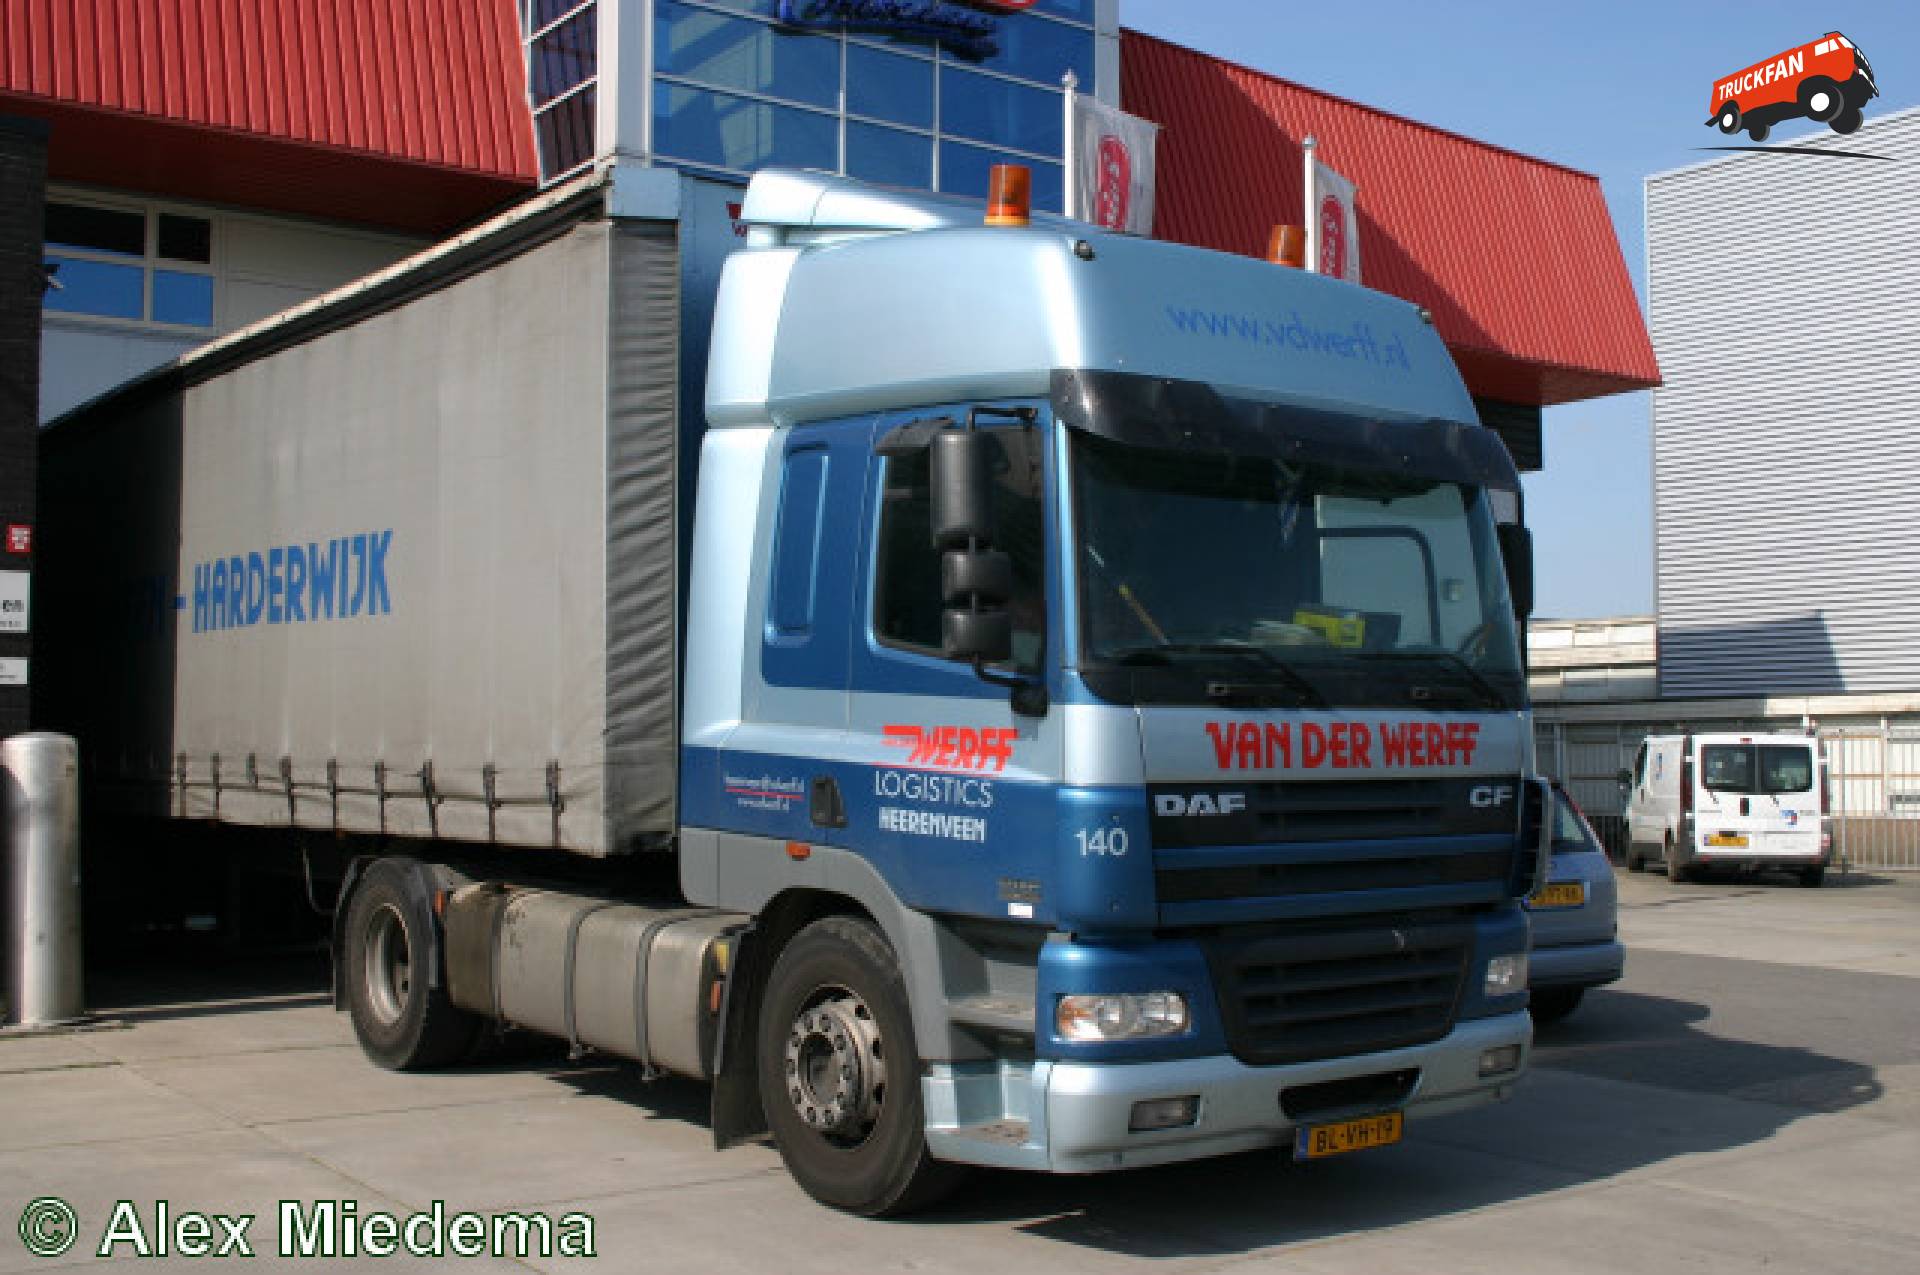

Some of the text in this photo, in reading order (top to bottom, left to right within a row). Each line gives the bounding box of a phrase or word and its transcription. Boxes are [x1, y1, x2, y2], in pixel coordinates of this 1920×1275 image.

[1166, 304, 1412, 369] www.vdwerff.nl
[192, 528, 394, 634] HARDERWIJK
[882, 725, 1019, 771] WERFF
[1205, 722, 1480, 769] VAN DER WERFF
[874, 770, 994, 808] LOGISTICS
[1155, 793, 1247, 817] DAF
[1469, 785, 1513, 808] CF
[878, 806, 986, 843] HEERENVEEN
[1073, 827, 1129, 857] 140
